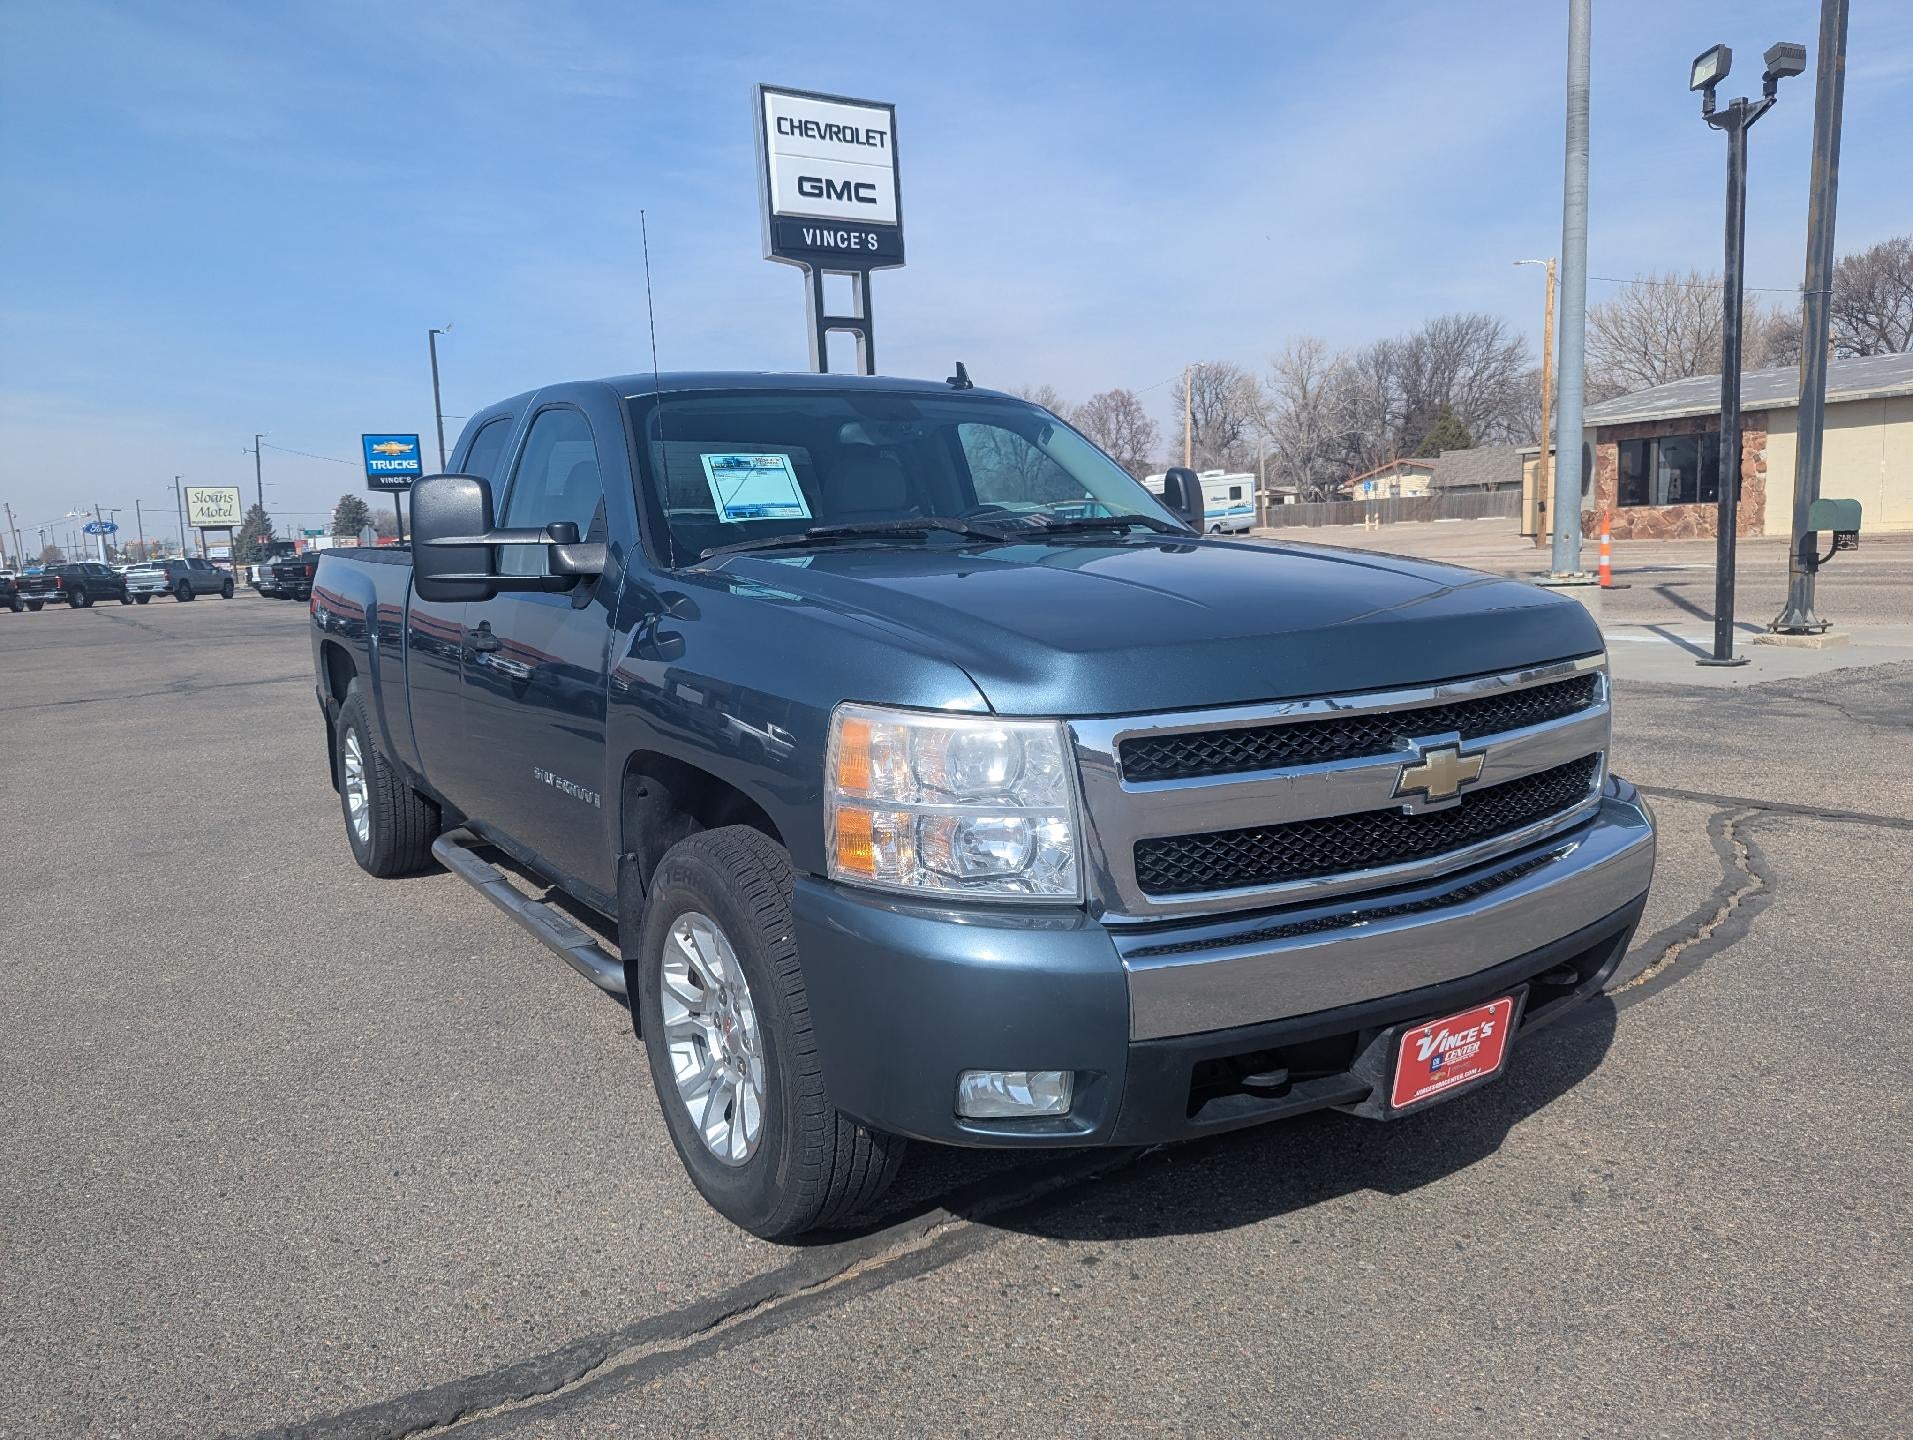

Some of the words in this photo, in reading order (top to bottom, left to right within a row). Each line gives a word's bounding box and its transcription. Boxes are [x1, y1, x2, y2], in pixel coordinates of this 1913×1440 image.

[776, 116, 887, 148] CHEVROLET
[797, 175, 877, 204] GMC
[803, 228, 878, 251] VINCE'S
[370, 460, 418, 470] TRUCKS
[192, 490, 234, 504] Sloans
[195, 504, 233, 518] Motel
[1444, 1041, 1480, 1062] CENTER
